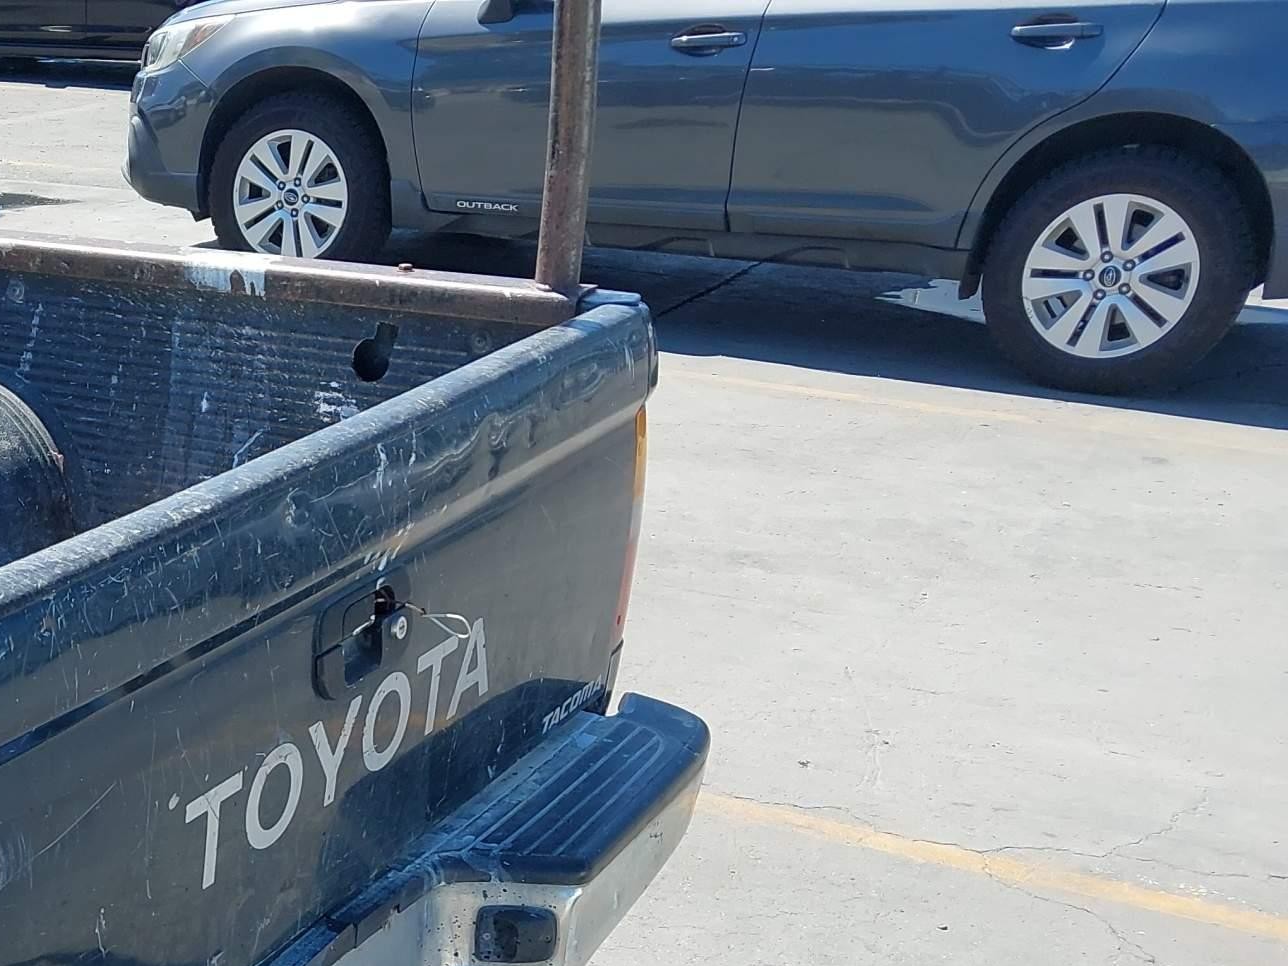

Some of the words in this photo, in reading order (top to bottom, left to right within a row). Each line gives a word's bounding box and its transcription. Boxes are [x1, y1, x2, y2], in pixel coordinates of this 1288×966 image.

[456, 200, 519, 212] OUTBACK
[542, 674, 602, 735] TACOMA
[185, 617, 489, 890] TOYOTA
